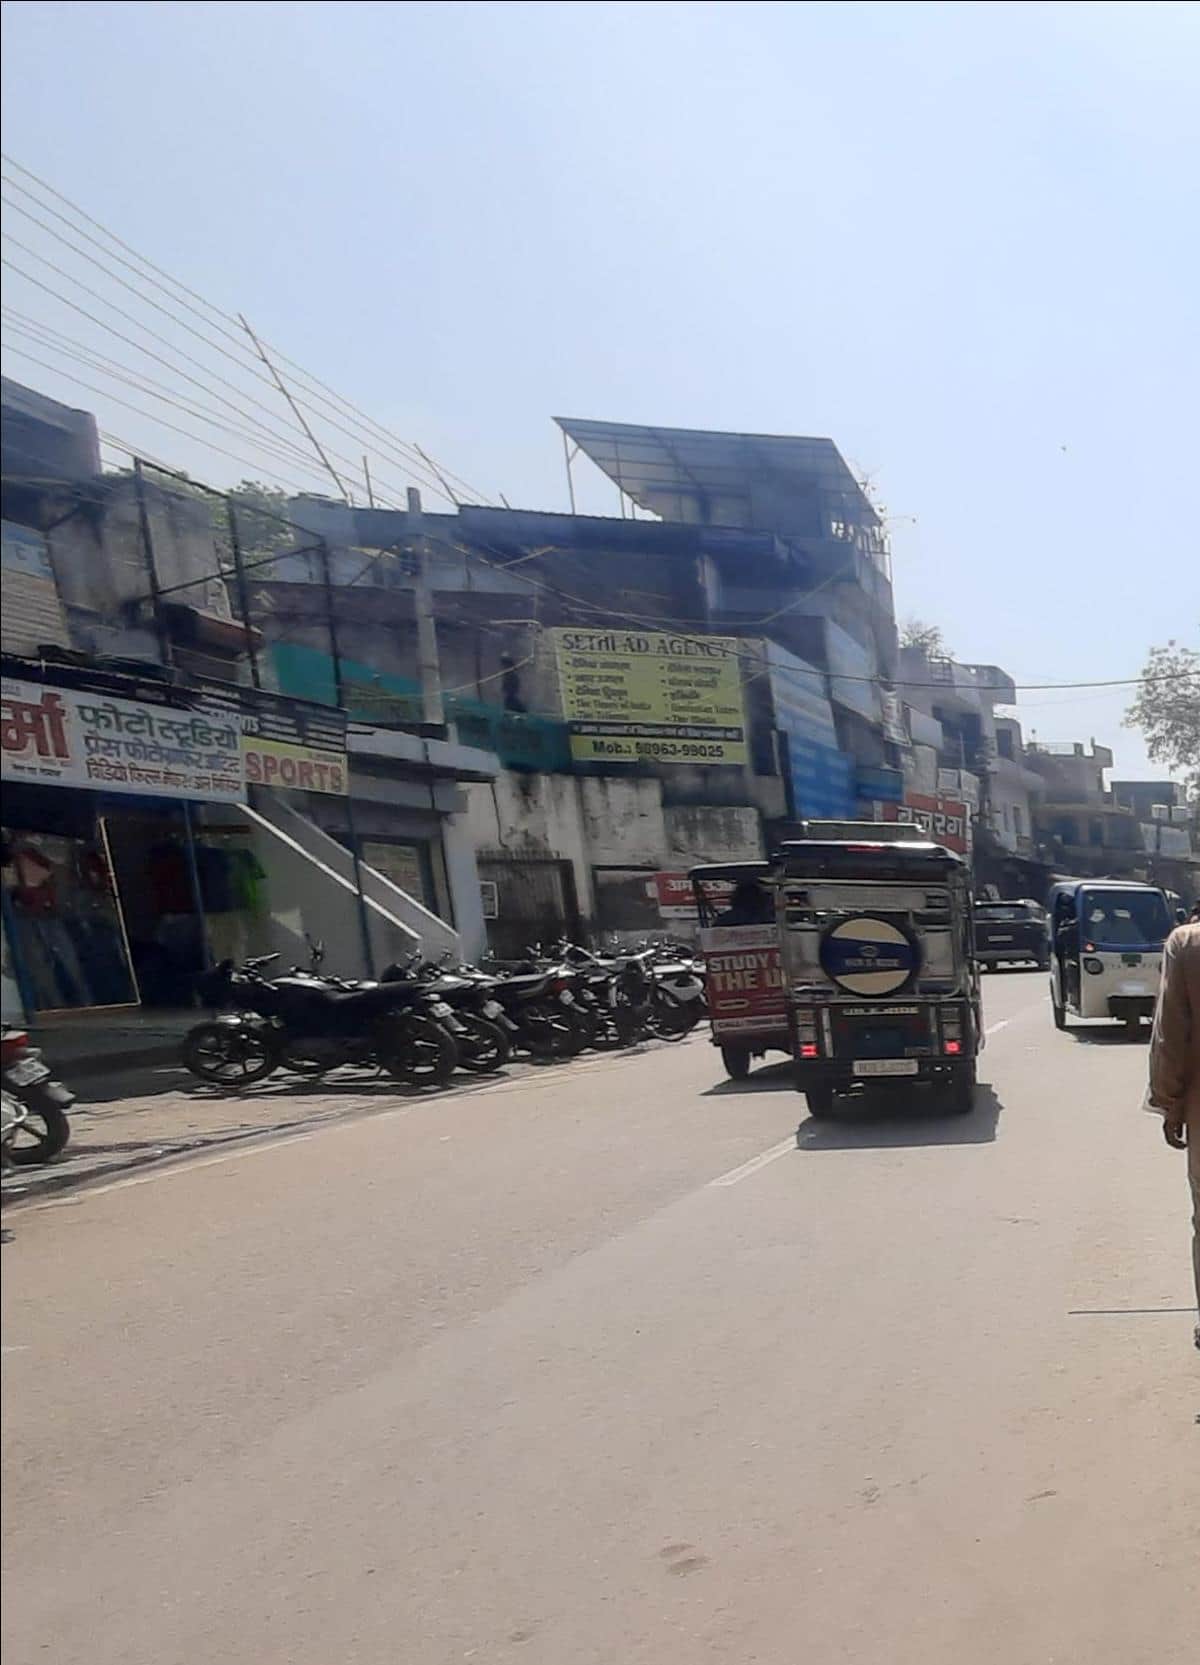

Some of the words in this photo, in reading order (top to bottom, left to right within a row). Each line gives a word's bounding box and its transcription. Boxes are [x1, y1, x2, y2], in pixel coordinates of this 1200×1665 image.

[626, 637, 649, 653] AD
[77, 701, 156, 738] फोटो
[245, 752, 343, 793] SPORTS
[708, 953, 770, 972] STUDY
[711, 970, 759, 992] THE
